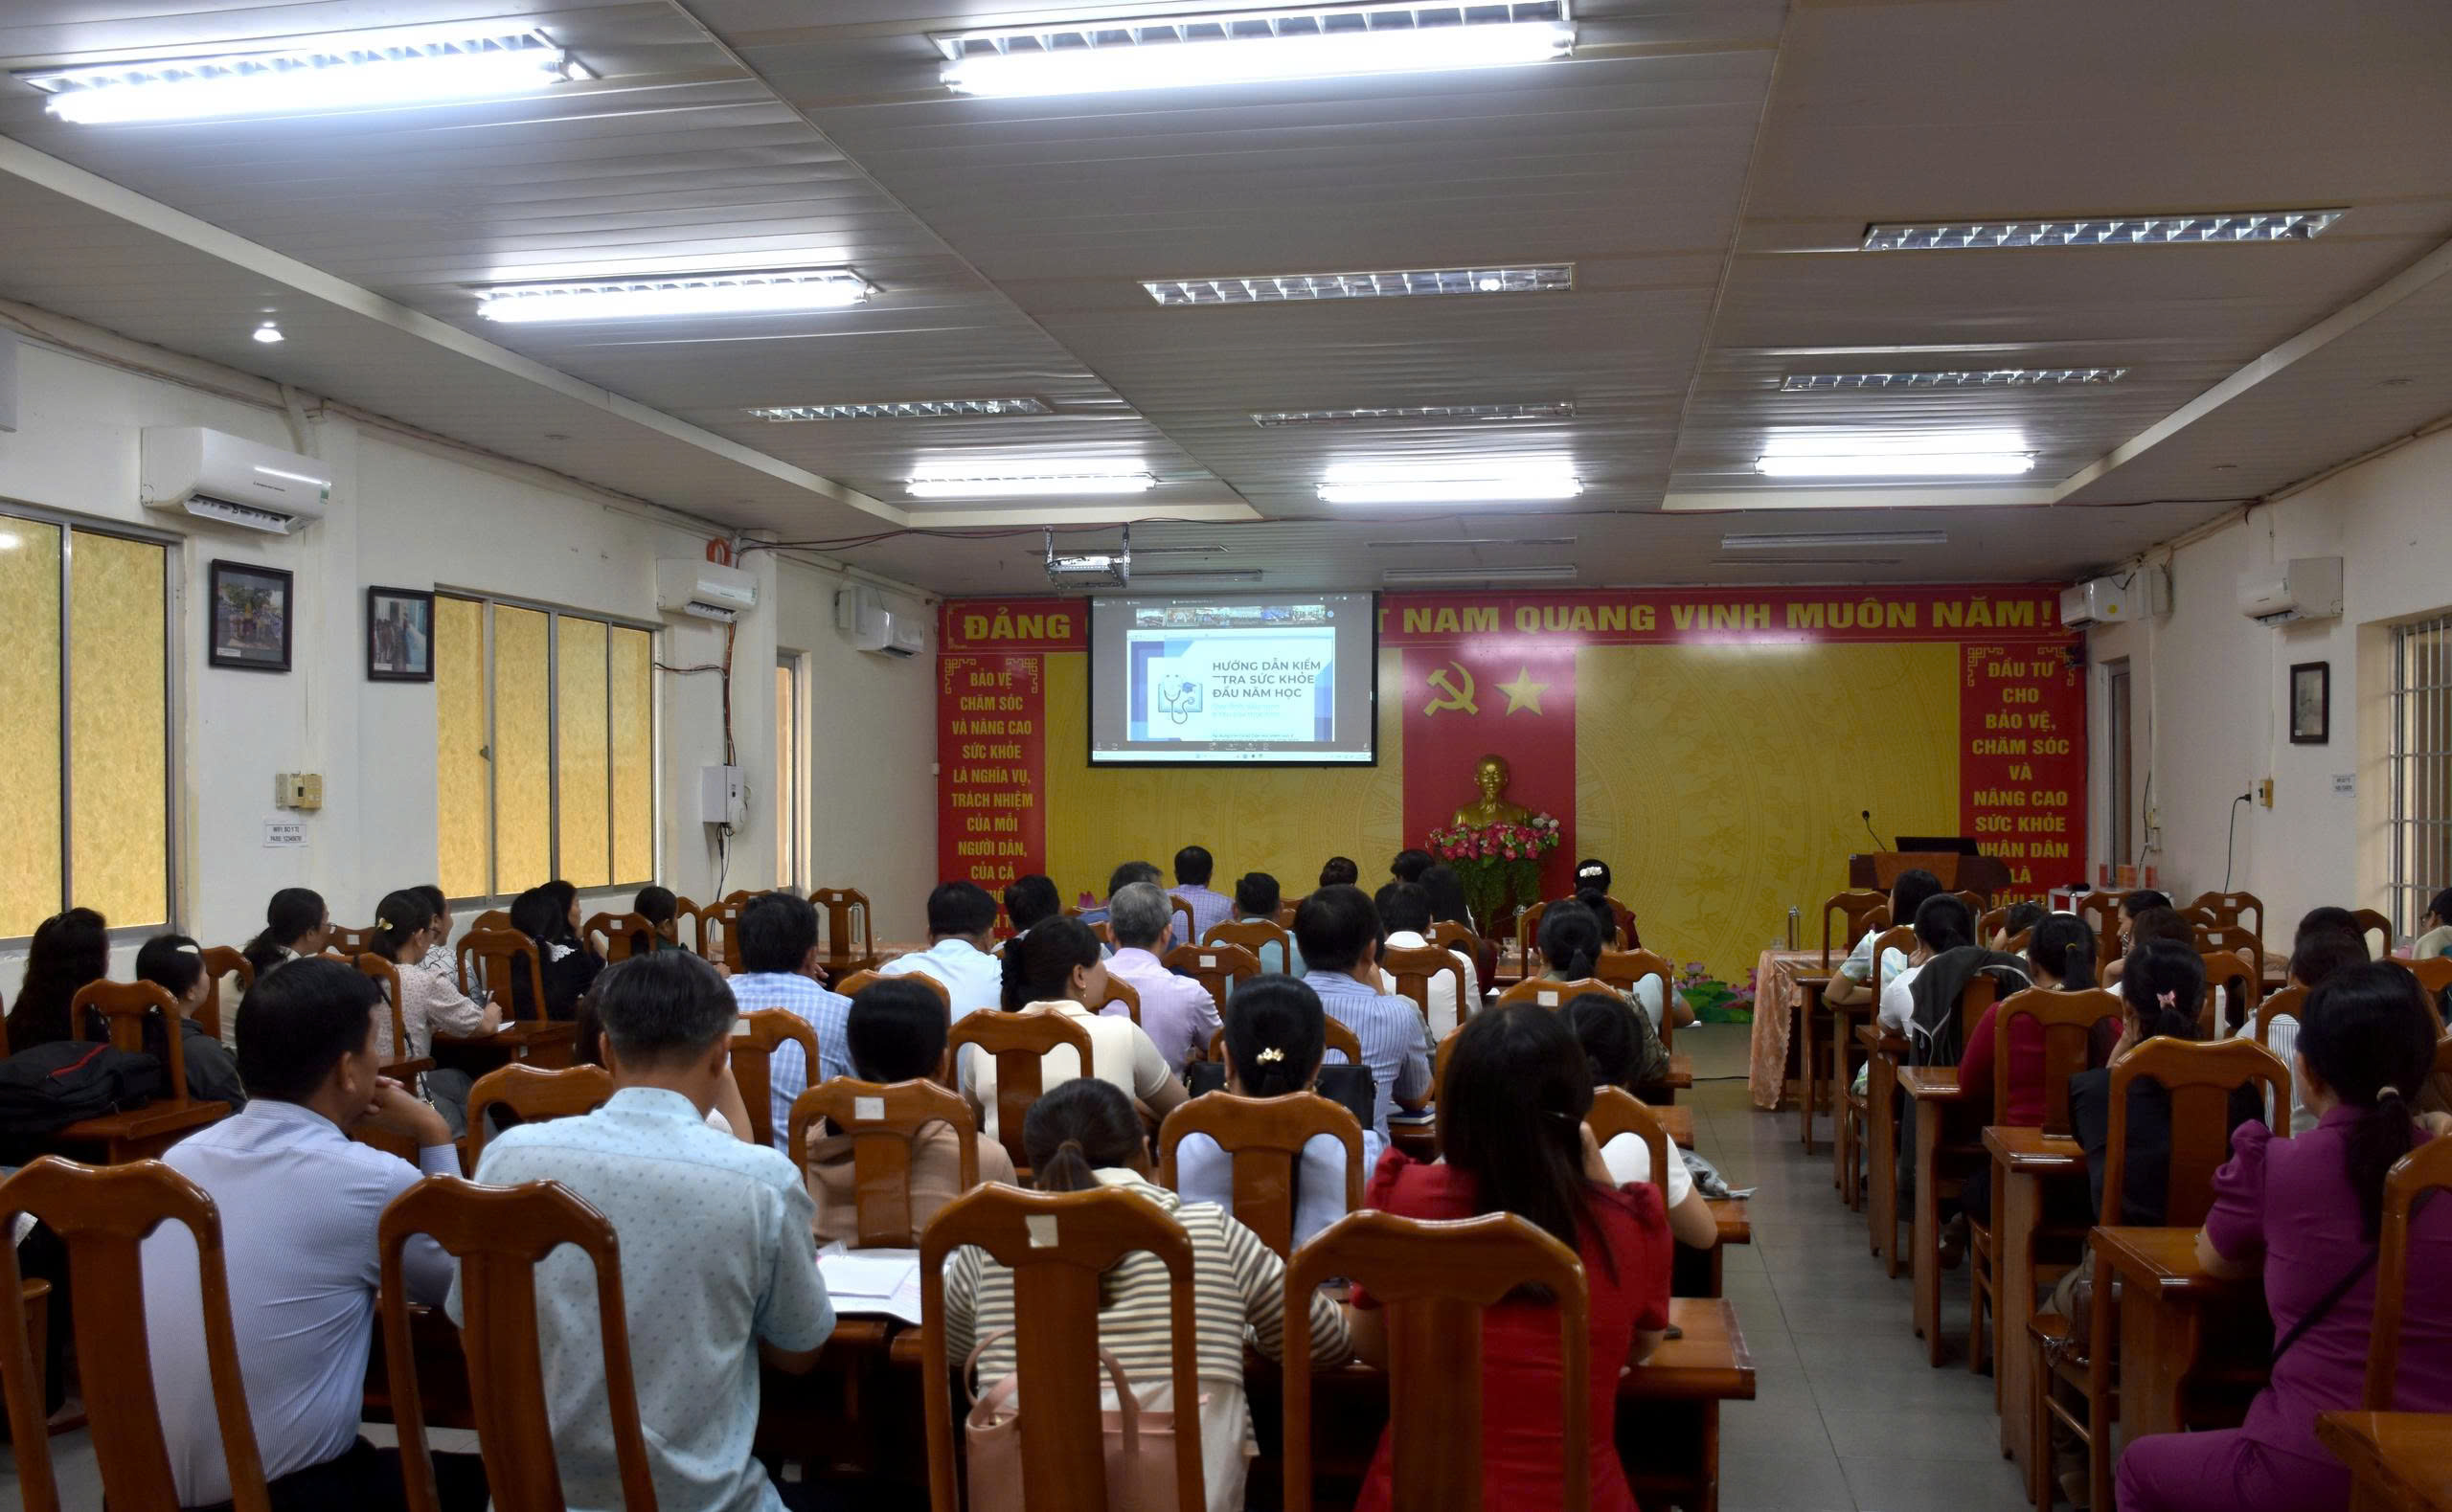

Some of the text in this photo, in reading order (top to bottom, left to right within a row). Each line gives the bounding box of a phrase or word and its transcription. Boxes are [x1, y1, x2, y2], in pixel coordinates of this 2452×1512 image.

[964, 606, 1071, 640] ĐẢNG
[1403, 607, 1499, 633] NAM
[1514, 605, 1656, 635] QUANG
[1670, 603, 1770, 630] VINH
[1786, 598, 1916, 629] MUÔN
[1213, 657, 1321, 670] HƯỚNG DẪN KIỂM
[1987, 657, 2055, 678] ĐẦU TƯ
[970, 667, 1012, 689] BẢO VỆ
[1222, 671, 1315, 685] TRA SỨC KHỎE
[960, 693, 1024, 711] CHĂM SÓC
[1213, 685, 1302, 700] ĐẦU NĂM HỌC
[2002, 688, 2039, 703] CHO
[952, 718, 1033, 735] VÀ NÂNG CAO
[1986, 709, 2023, 729] BẢO
[963, 740, 1021, 759] SỨC KHỎE
[1972, 735, 2070, 755] CHĂM SÓC
[953, 766, 968, 783] LÀ
[971, 766, 1008, 783] NGHĨA
[2009, 762, 2032, 780] VÀ
[951, 790, 1033, 810] TRÁCH NHIỆM
[1973, 788, 2068, 806] NÂNG CAO
[966, 812, 1018, 832] CỦA MỖI
[1975, 811, 2067, 832] SỨC KHỎE
[958, 837, 1027, 857] NGƯỜI DÂN,
[2031, 839, 2069, 858] DÂN
[970, 861, 1015, 880] CỦA CẢ
[2009, 866, 2032, 883] LÀ
